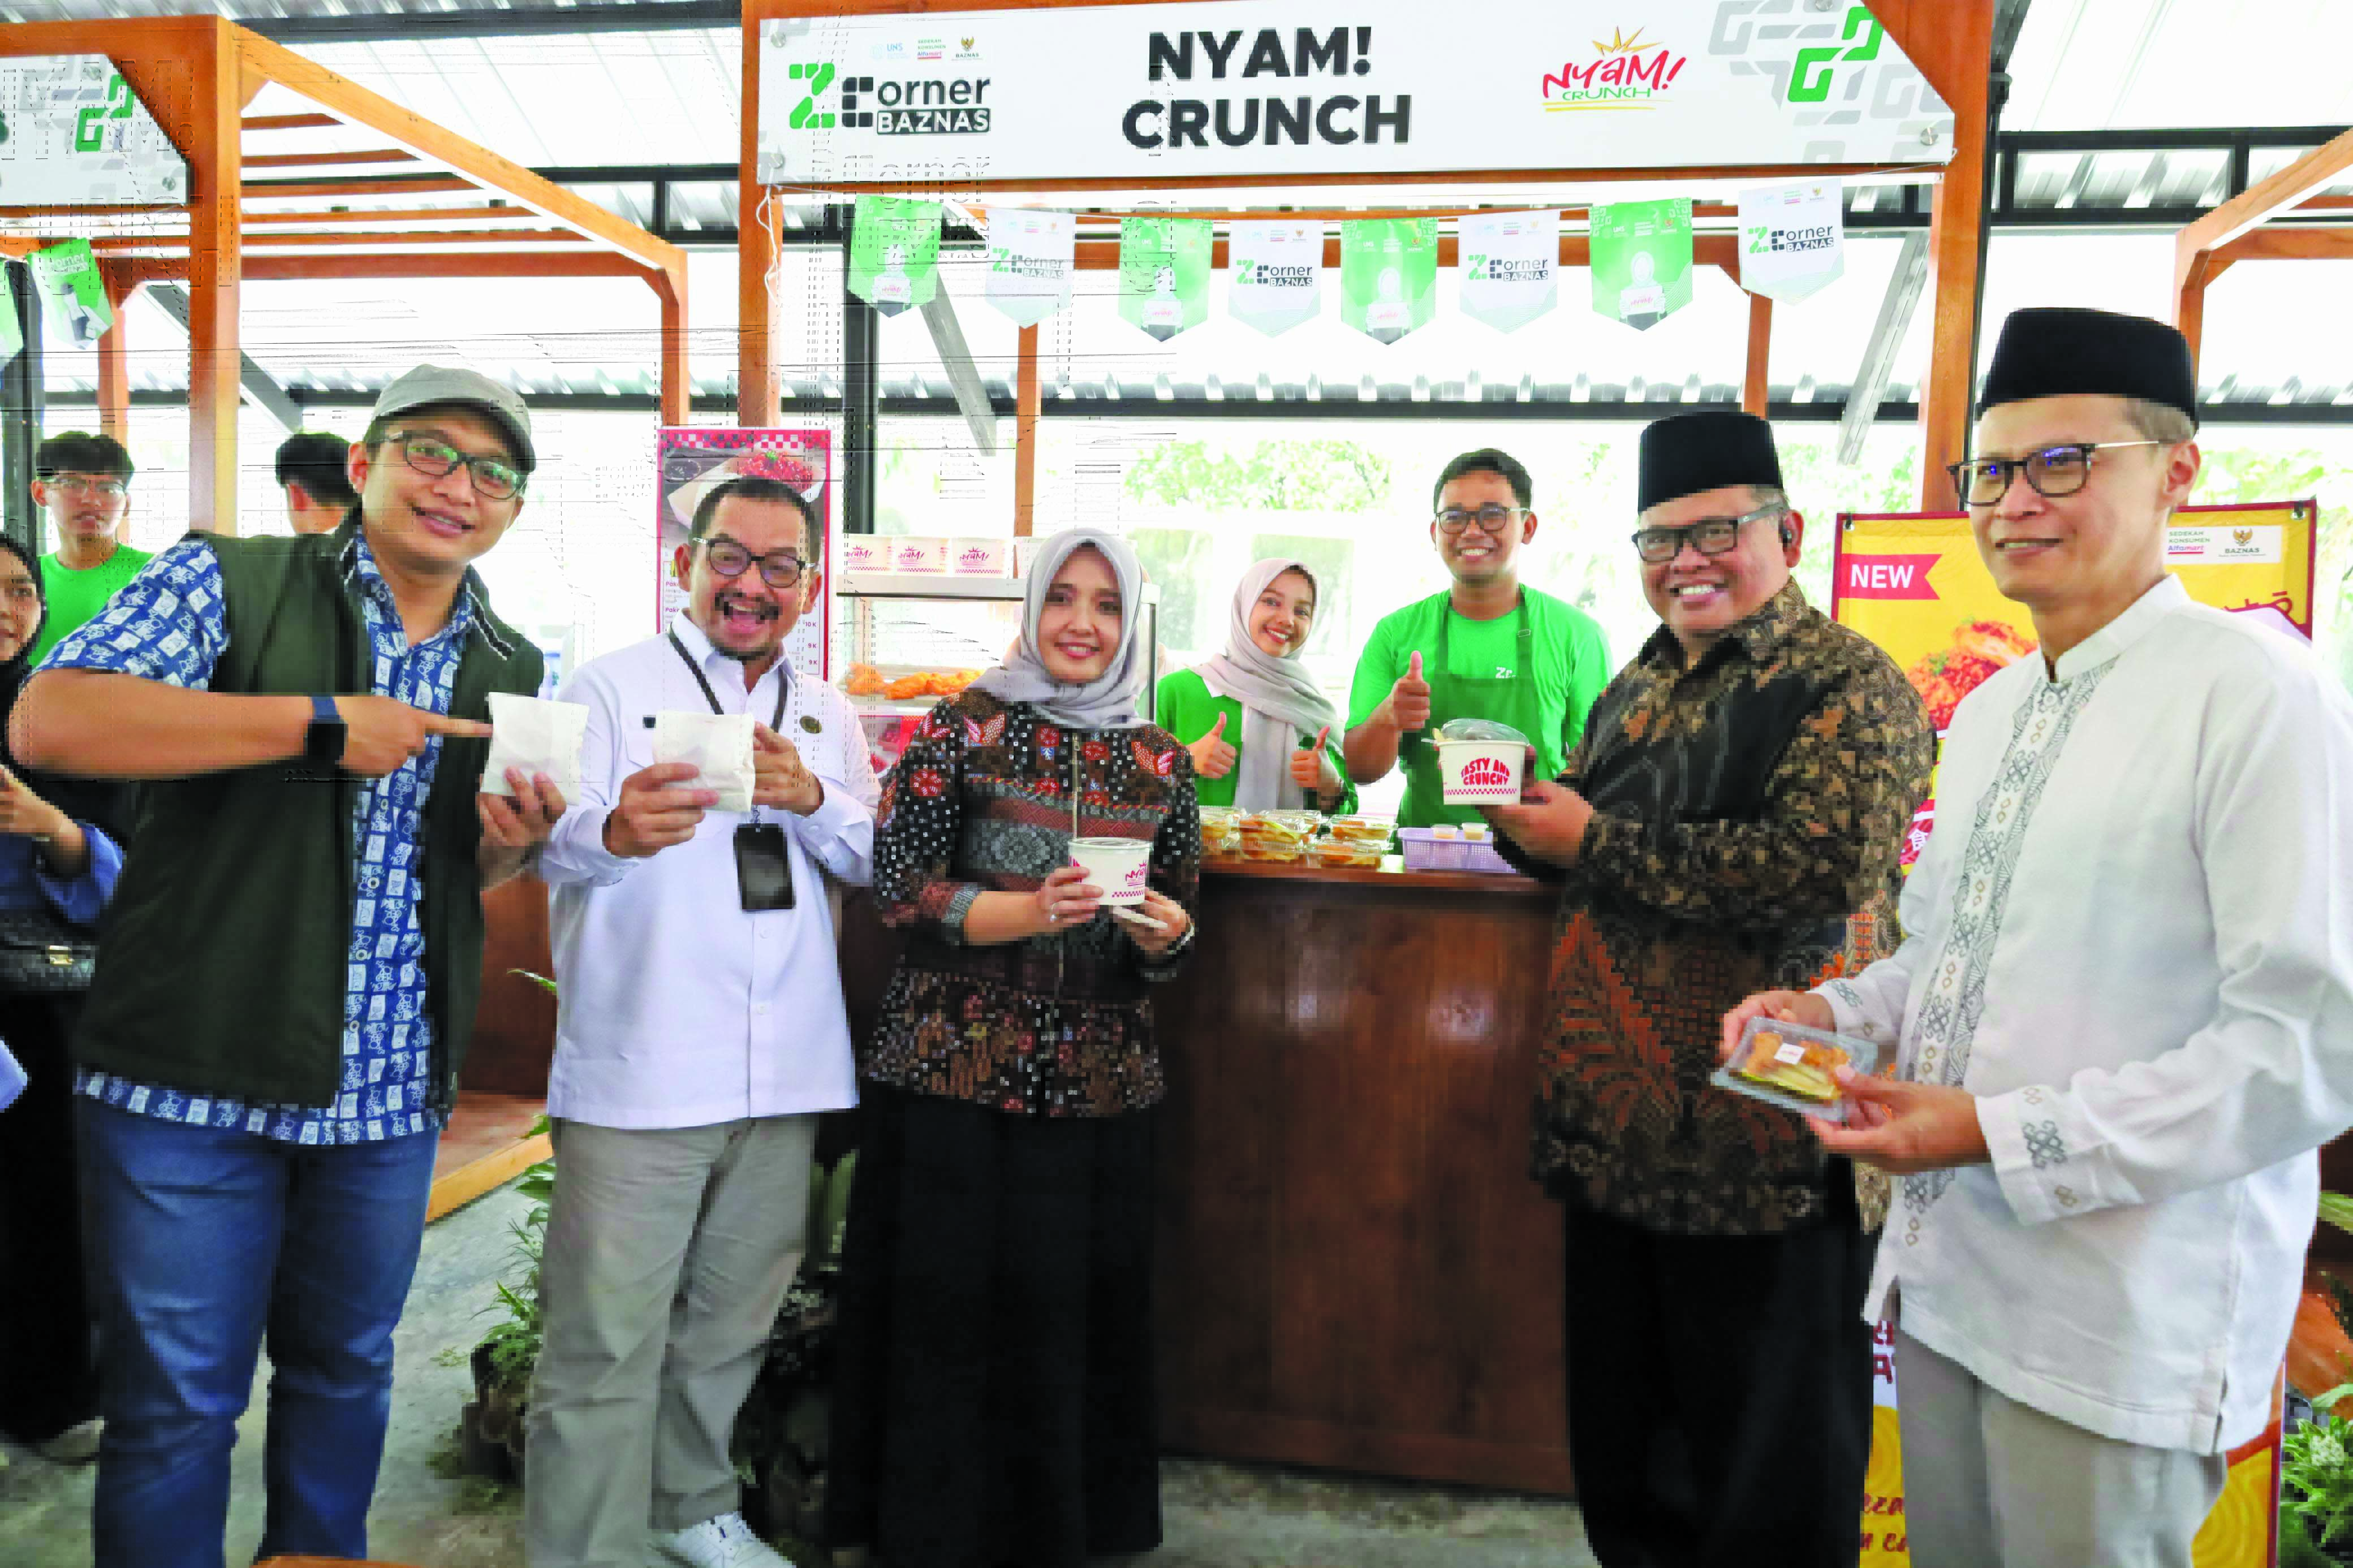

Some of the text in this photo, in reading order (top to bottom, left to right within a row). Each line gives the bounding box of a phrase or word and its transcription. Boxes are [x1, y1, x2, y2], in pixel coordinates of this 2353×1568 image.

[887, 43, 903, 51] UNS
[1149, 26, 1372, 81] NYAM!
[1562, 87, 1651, 102] CRUNCH
[877, 109, 989, 134] BAZNAS
[1123, 94, 1411, 148] CRUNCH
[1787, 237, 1834, 252] BAZNAS
[1024, 268, 1064, 279] BAZNAS
[1503, 271, 1548, 281] BAZNAS
[1270, 278, 1313, 287] BAZNAS
[1851, 564, 1915, 589] NEW
[1463, 772, 1509, 785] CRUNCHY
